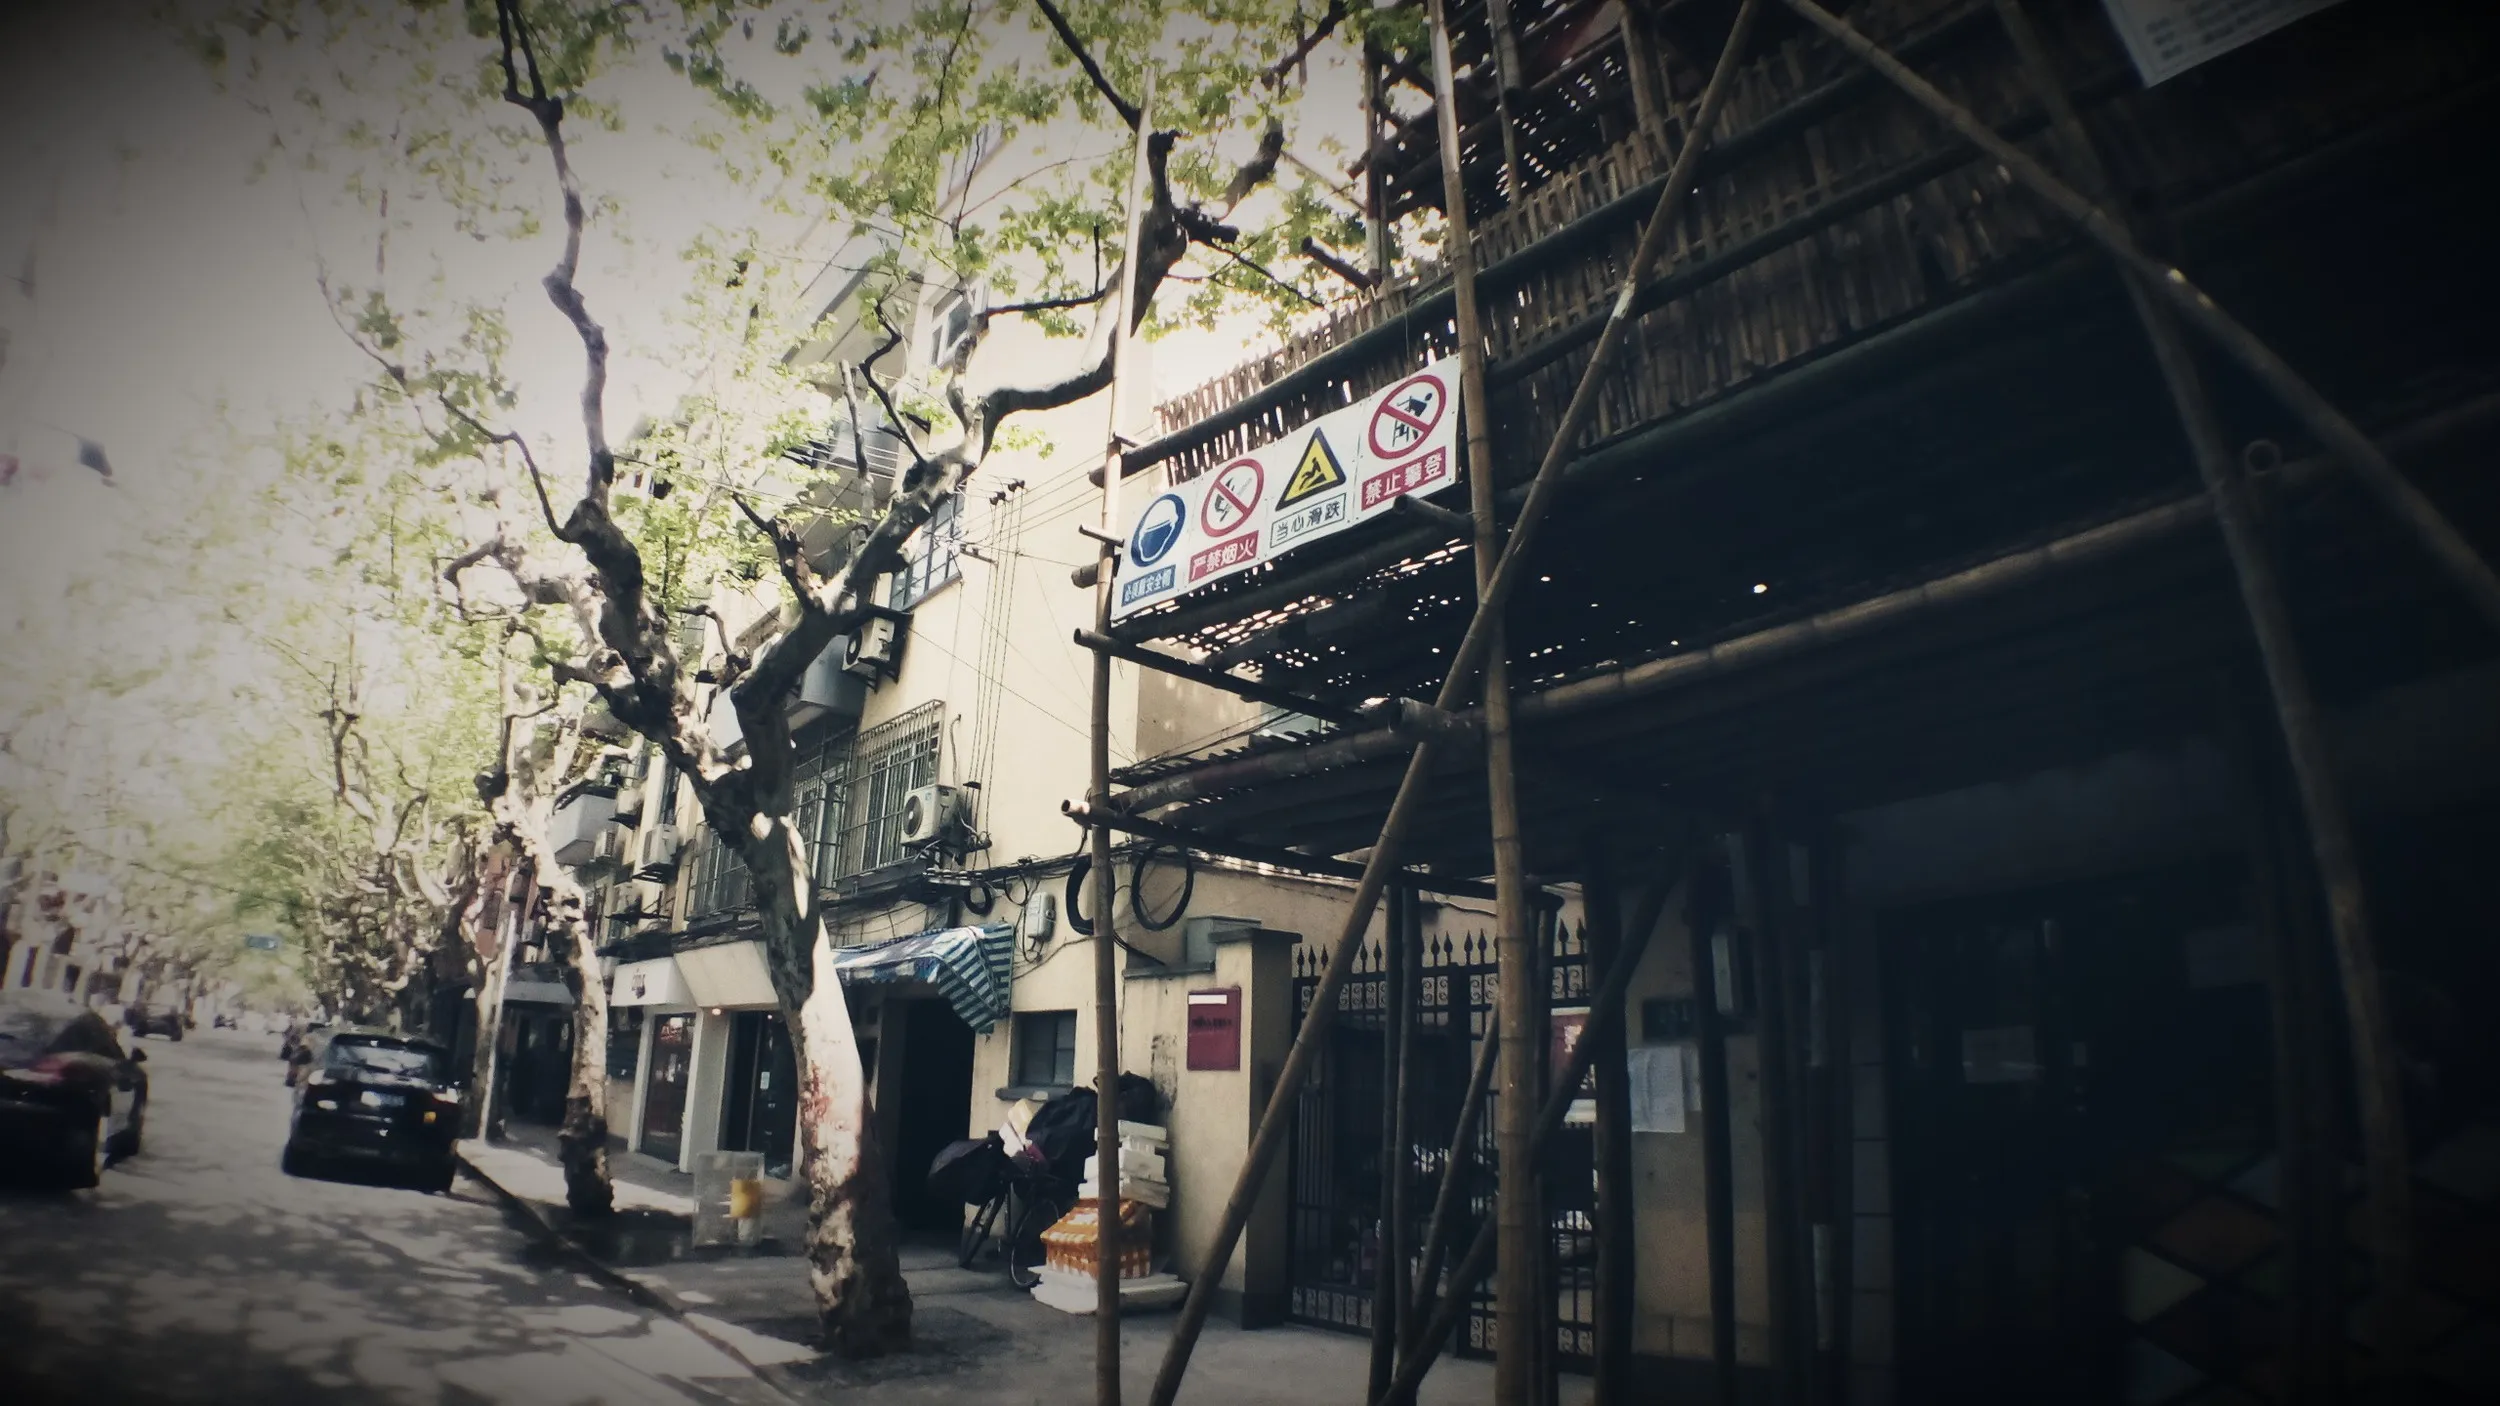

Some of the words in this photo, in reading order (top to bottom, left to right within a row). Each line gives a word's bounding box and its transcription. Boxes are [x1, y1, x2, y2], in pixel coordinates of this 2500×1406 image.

[1365, 453, 1442, 505] 禁止攀登
[1276, 501, 1340, 542] 当心滑跌
[1191, 538, 1255, 580] 严禁烟火
